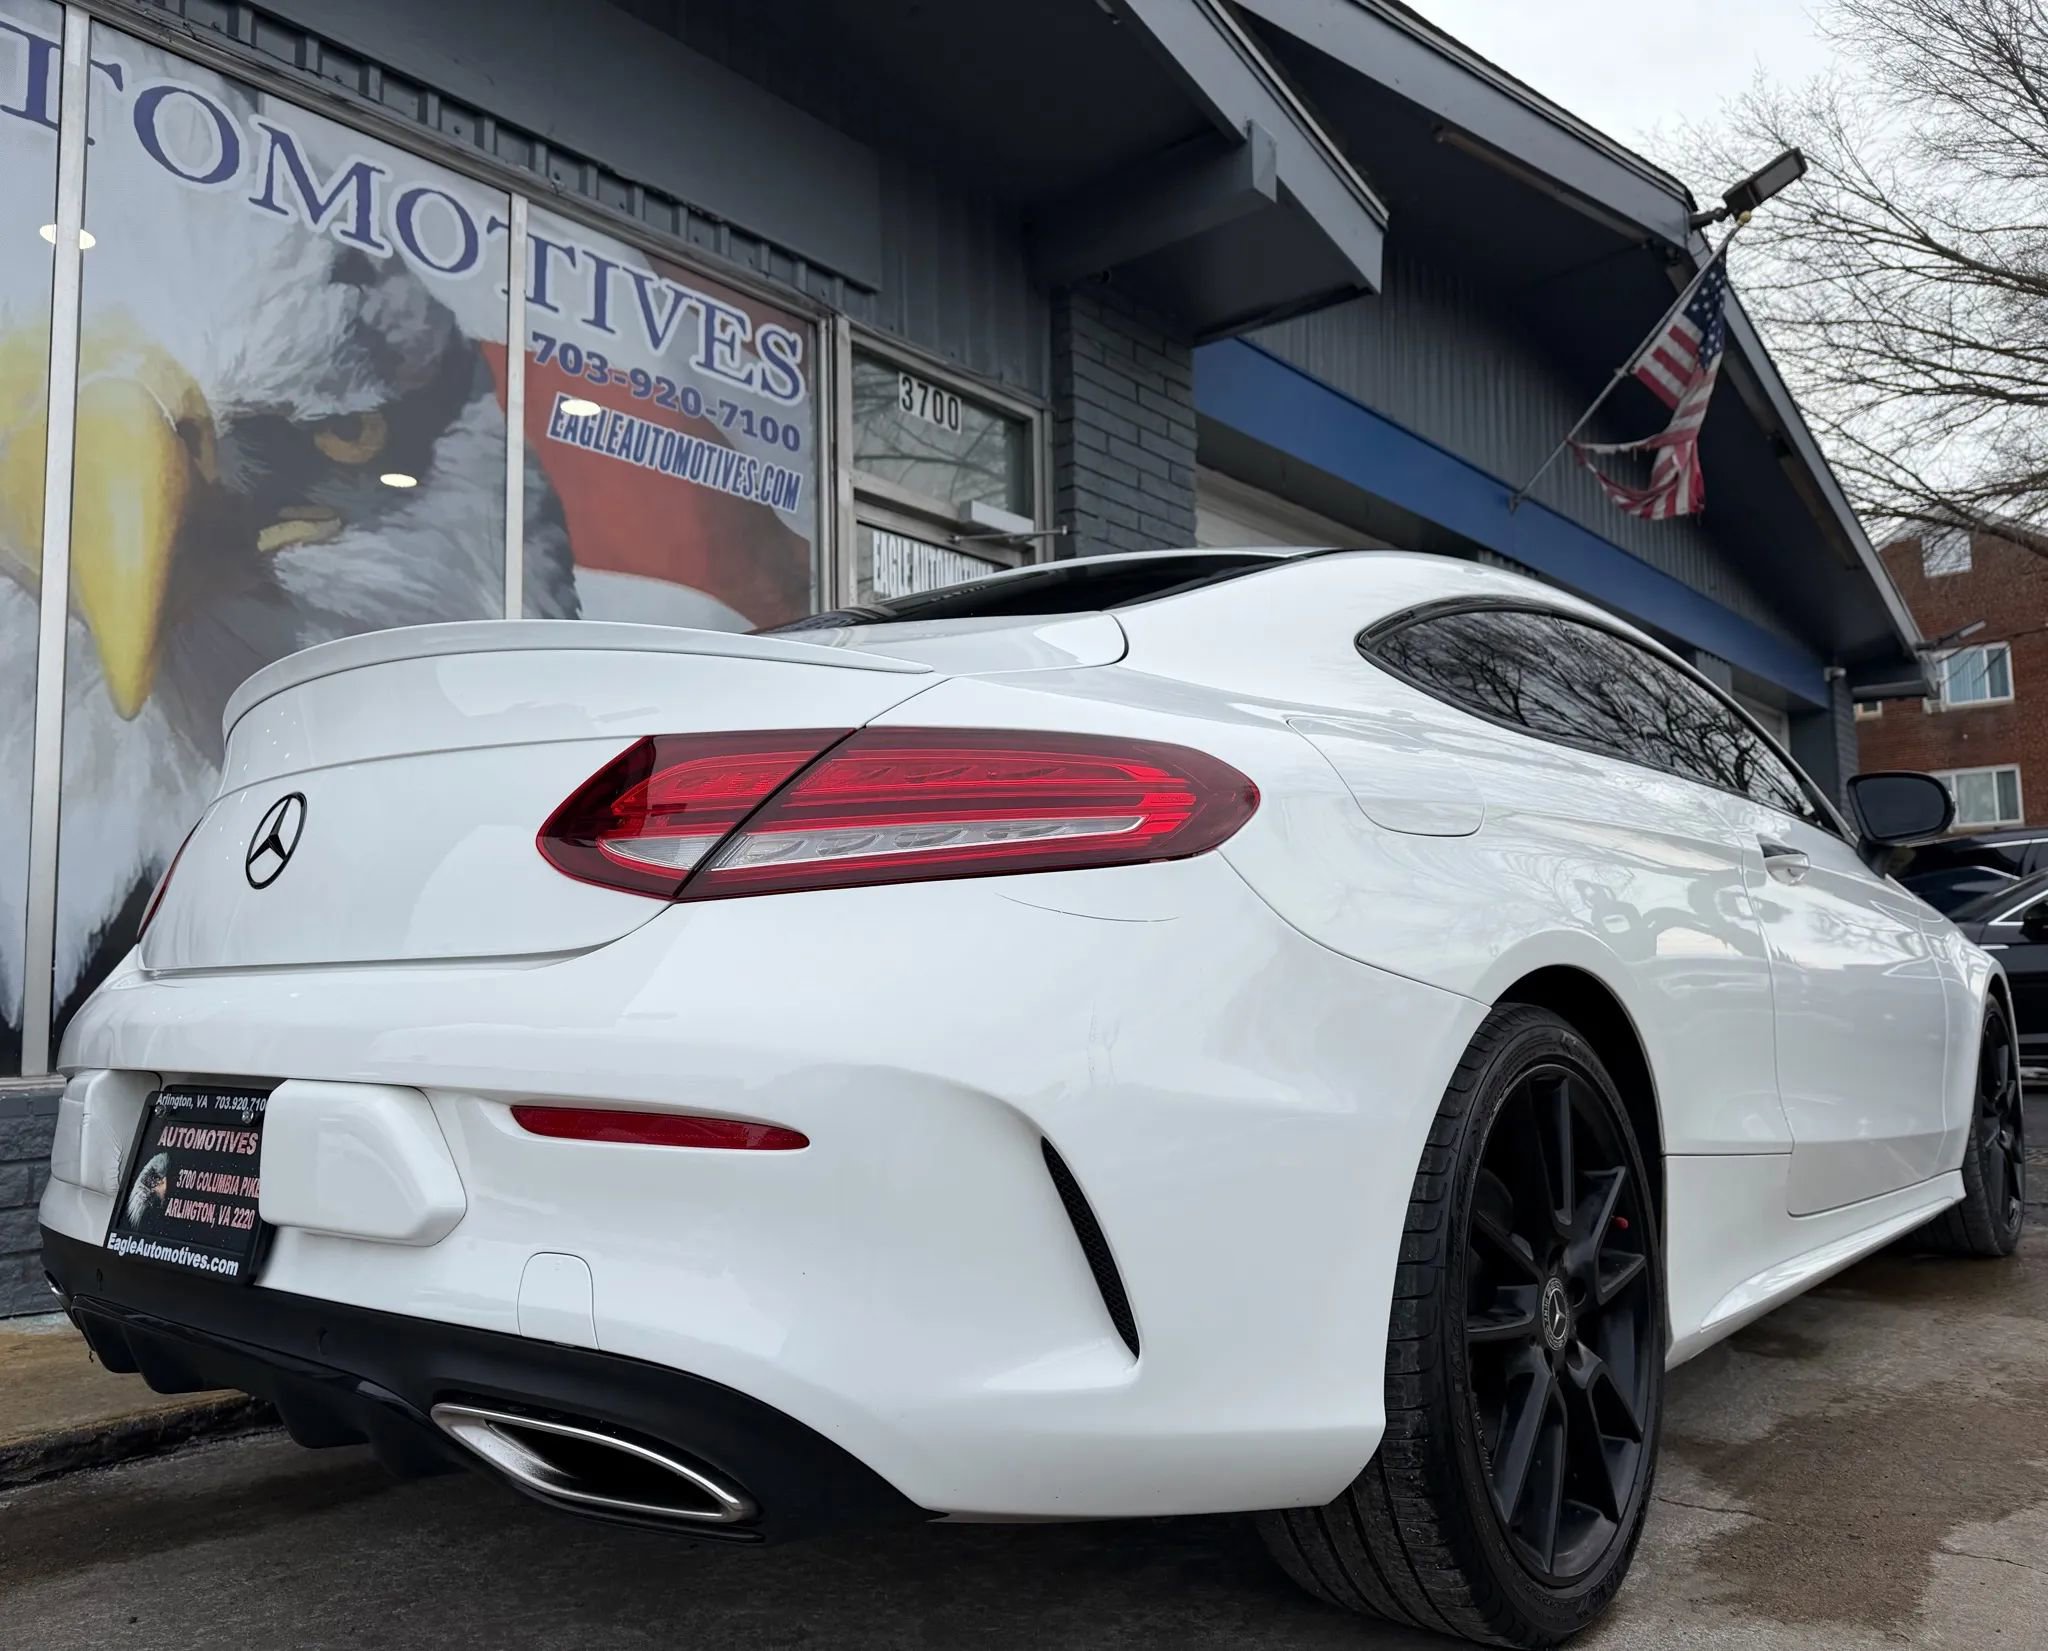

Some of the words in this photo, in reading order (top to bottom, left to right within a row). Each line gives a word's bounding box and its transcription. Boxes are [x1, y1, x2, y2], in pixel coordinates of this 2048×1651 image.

[0, 20, 801, 400] TOMOTIVES
[532, 331, 800, 451] 703-920-7100
[902, 376, 959, 431] 3700
[550, 395, 801, 511] EAGLEAUTOMOTIVES.COM
[156, 1093, 193, 1110] Arlington,
[197, 1095, 208, 1108] VA
[157, 1126, 258, 1155] AUTOMOTIVES
[196, 1171, 240, 1195] COLUMBIA
[164, 1198, 215, 1228] ARLINGTON,
[217, 1205, 231, 1226] VA
[107, 1232, 239, 1276] EagleAutomotives.com
